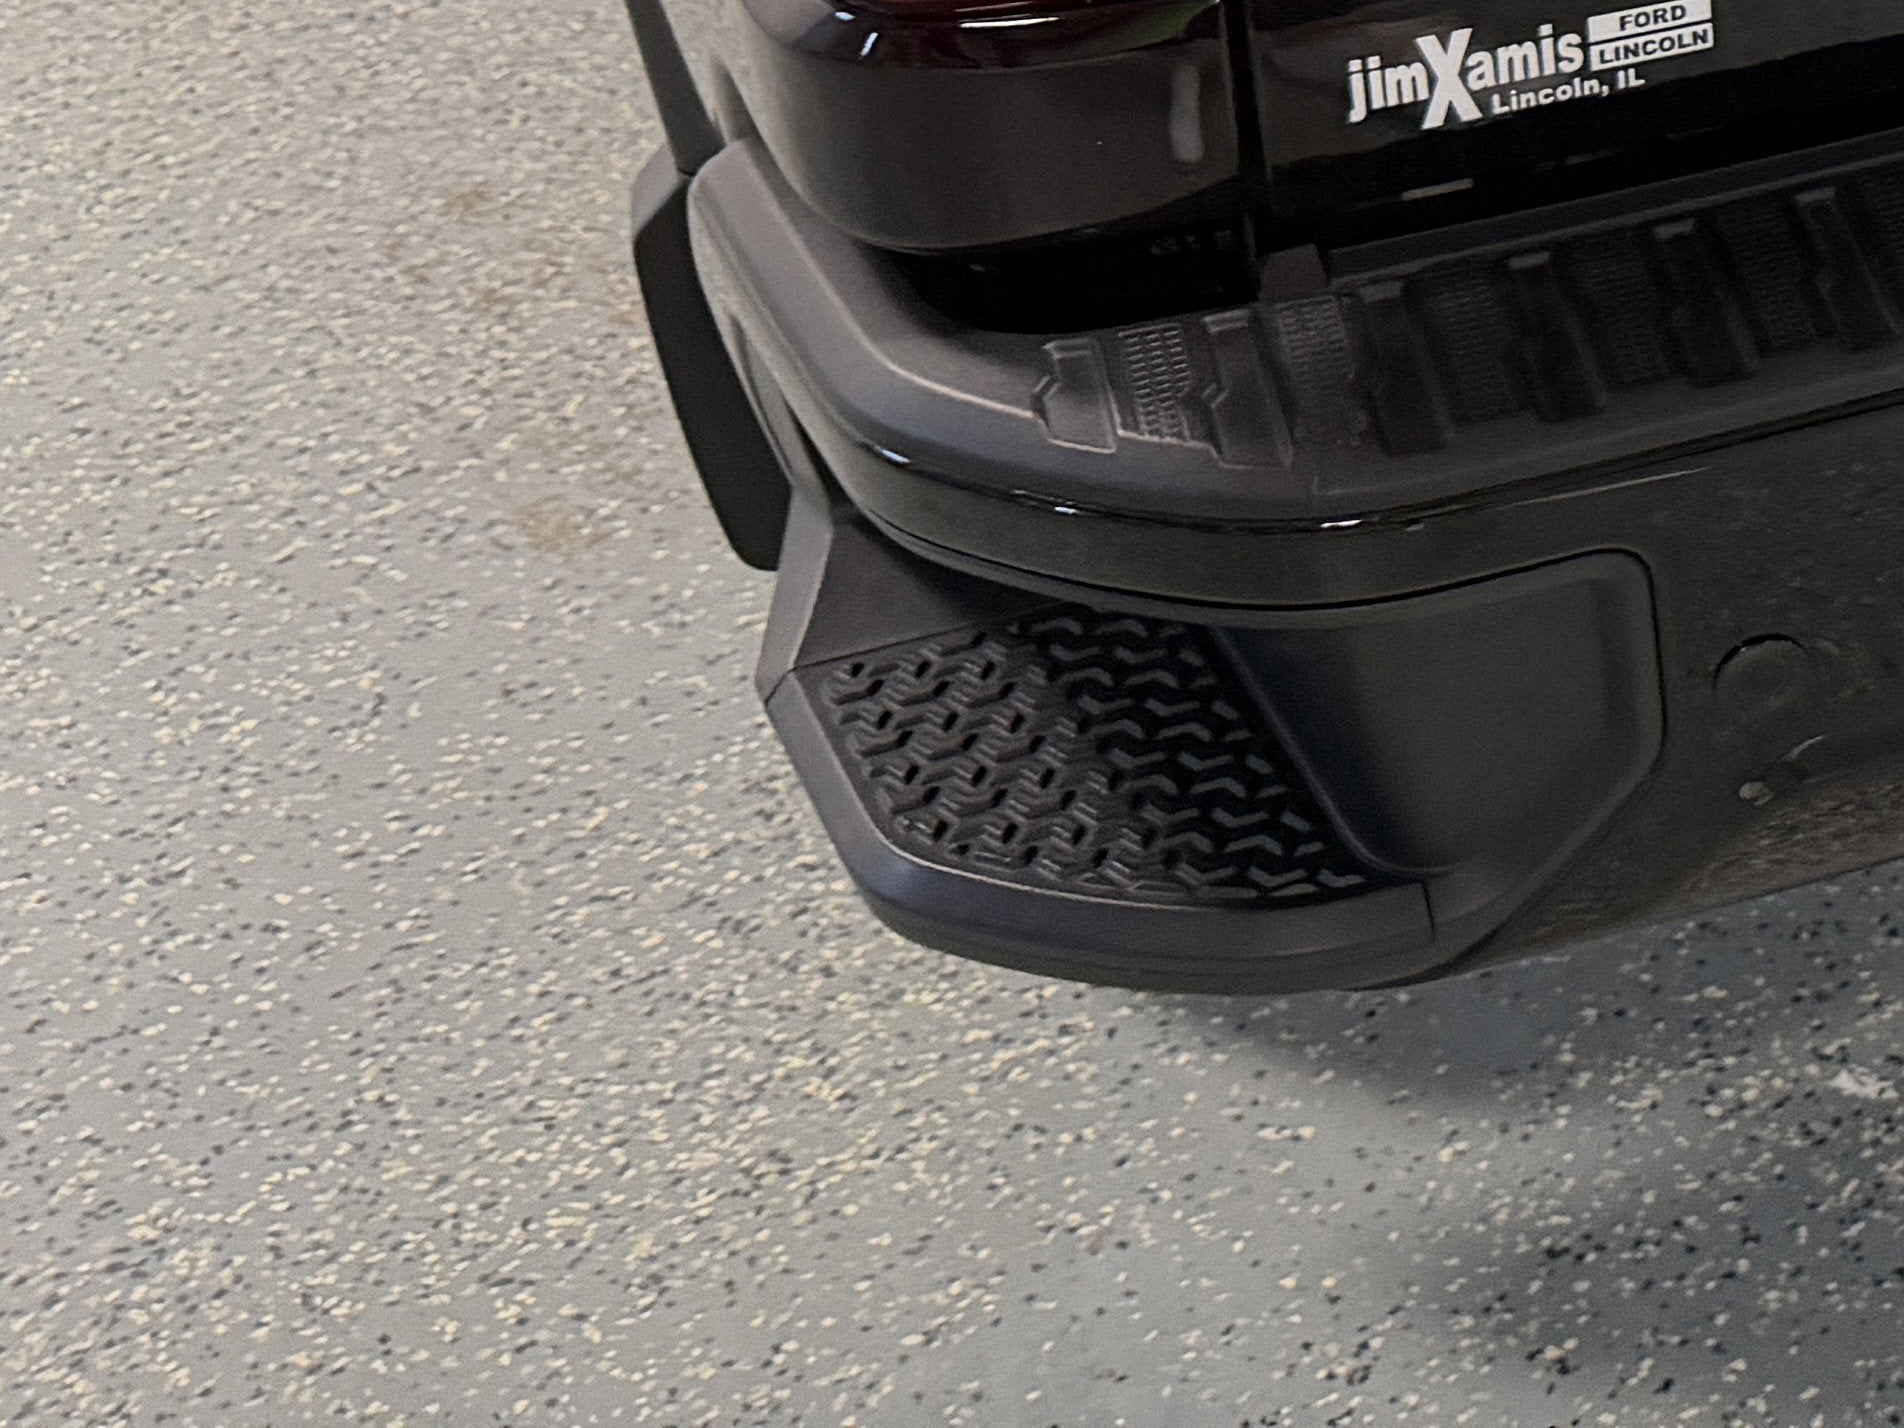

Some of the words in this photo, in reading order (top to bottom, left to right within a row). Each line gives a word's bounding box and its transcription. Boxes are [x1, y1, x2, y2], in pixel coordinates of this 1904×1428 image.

[1618, 3, 1687, 32] FORD
[1598, 28, 1710, 65] LINCOLN
[1346, 24, 1585, 131] jimXamis
[1492, 74, 1609, 116] Lincoln,
[1615, 68, 1646, 91] IL
